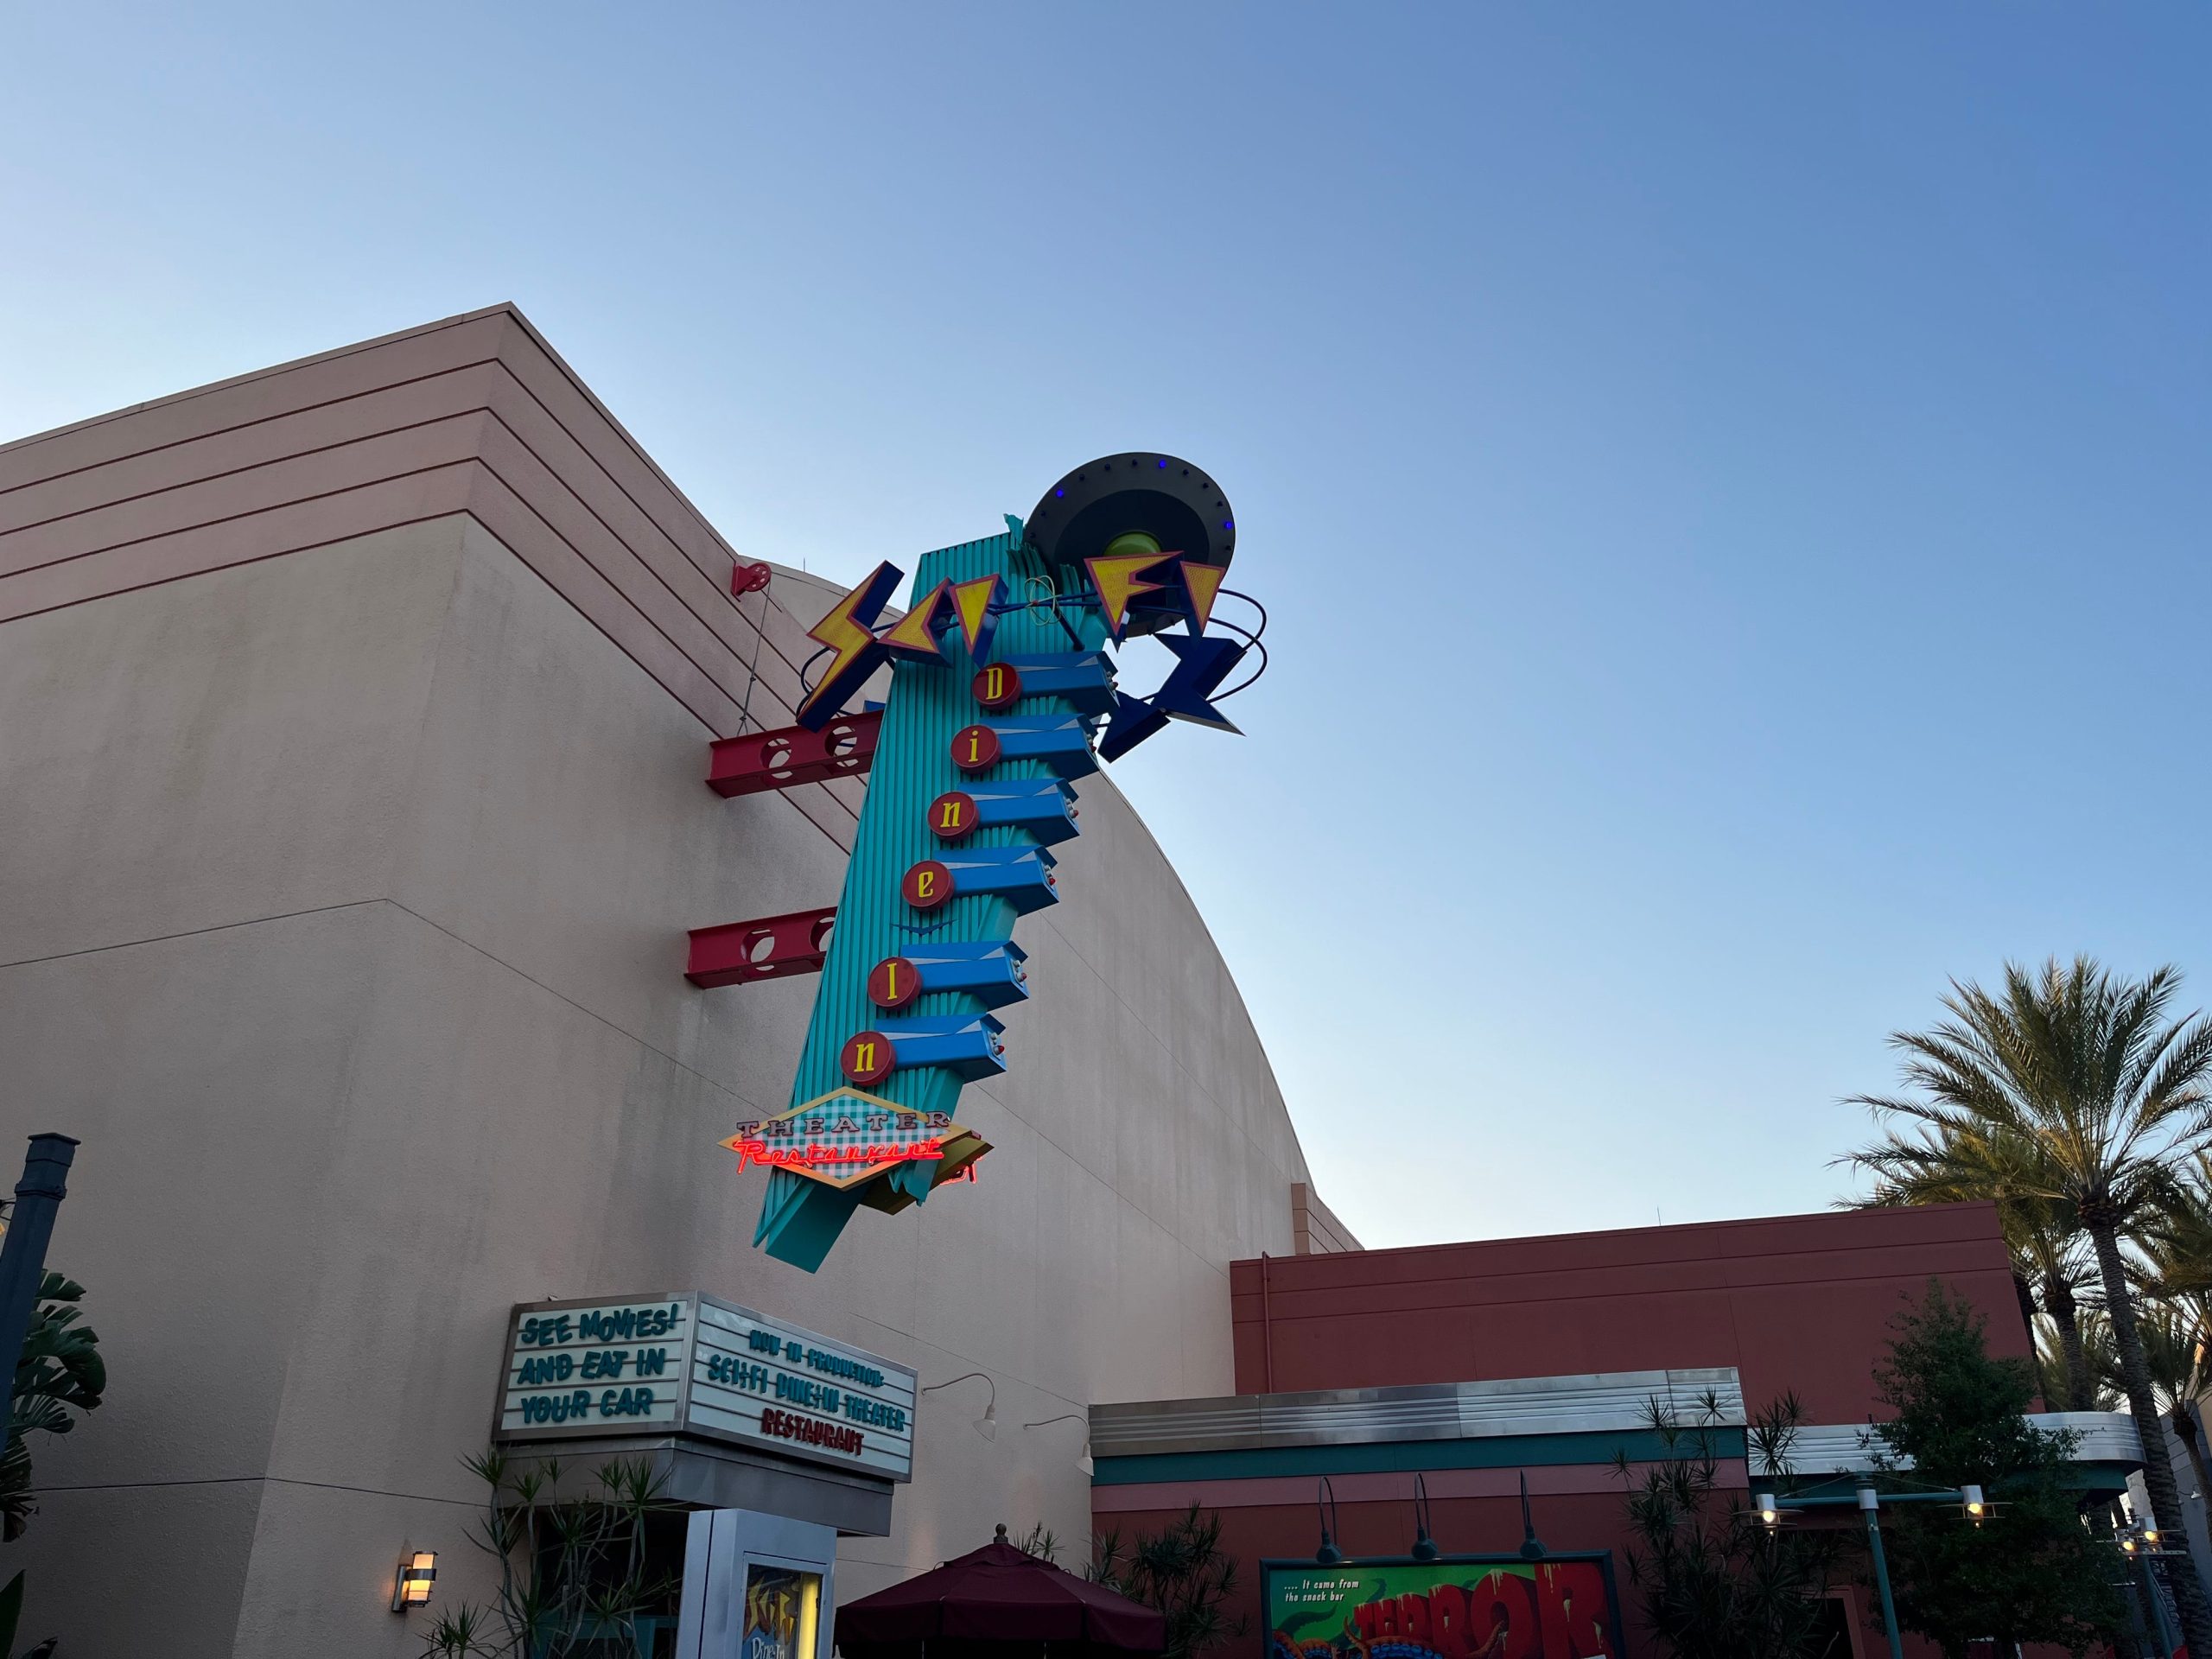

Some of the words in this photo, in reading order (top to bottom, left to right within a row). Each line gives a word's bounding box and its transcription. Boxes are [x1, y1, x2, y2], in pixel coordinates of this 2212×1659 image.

[736, 1110, 951, 1139] THEATER
[733, 1137, 944, 1175] Restaurant
[521, 1314, 573, 1346] SEE
[579, 1303, 678, 1341] MOVIES!
[749, 1329, 781, 1357] NOW
[786, 1341, 802, 1363] IN
[517, 1353, 574, 1384] AND
[581, 1351, 629, 1380] EAT
[636, 1348, 665, 1376] IN
[521, 1389, 590, 1424] YOUR
[600, 1387, 653, 1417] CAR
[708, 1354, 768, 1394] SCI-FI
[776, 1372, 839, 1414] DINE-IN
[844, 1394, 906, 1433] THEATER
[760, 1408, 864, 1456] RESTAURANT
[1285, 1592, 1299, 1602] the
[1302, 1592, 1326, 1602] snack
[1330, 1591, 1344, 1602] bar
[1313, 1580, 1335, 1589] came
[1338, 1578, 1360, 1589] from
[1354, 1562, 1611, 1659] TERROR
